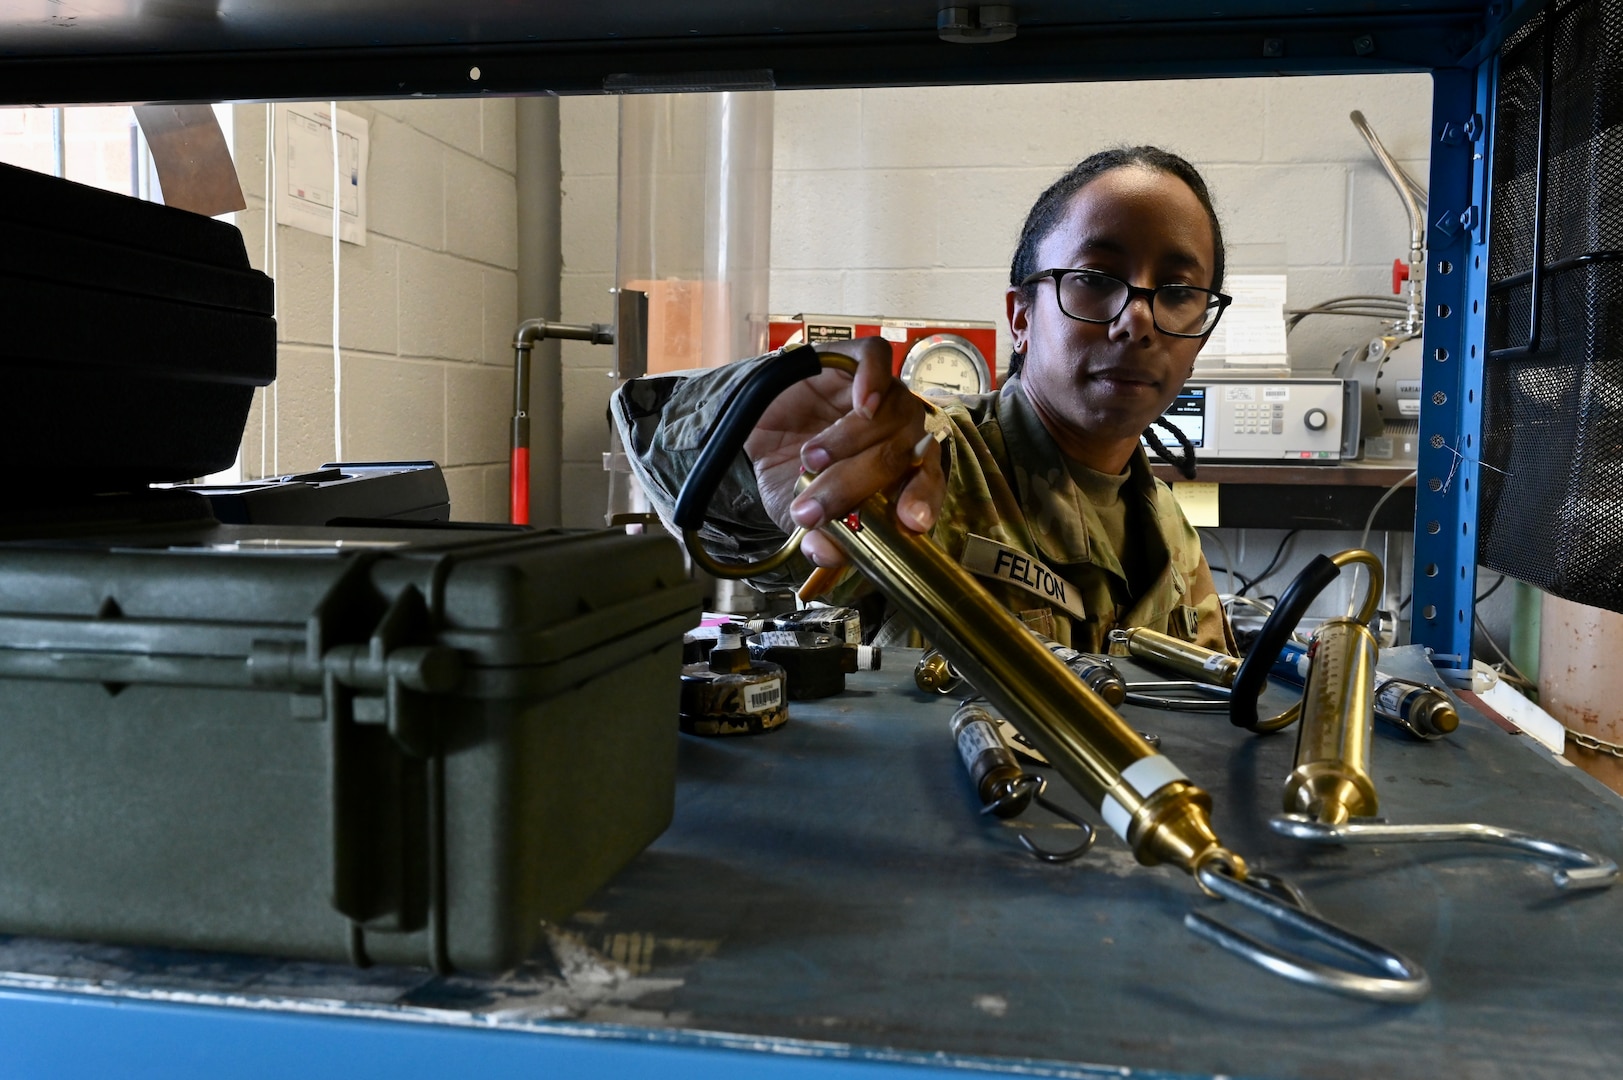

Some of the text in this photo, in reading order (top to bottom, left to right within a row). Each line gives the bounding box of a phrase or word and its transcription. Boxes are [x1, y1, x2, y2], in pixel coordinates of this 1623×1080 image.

[937, 356, 944, 364] 20
[951, 359, 958, 367] 30
[926, 363, 932, 371] 10
[994, 549, 1066, 603] FELTON
